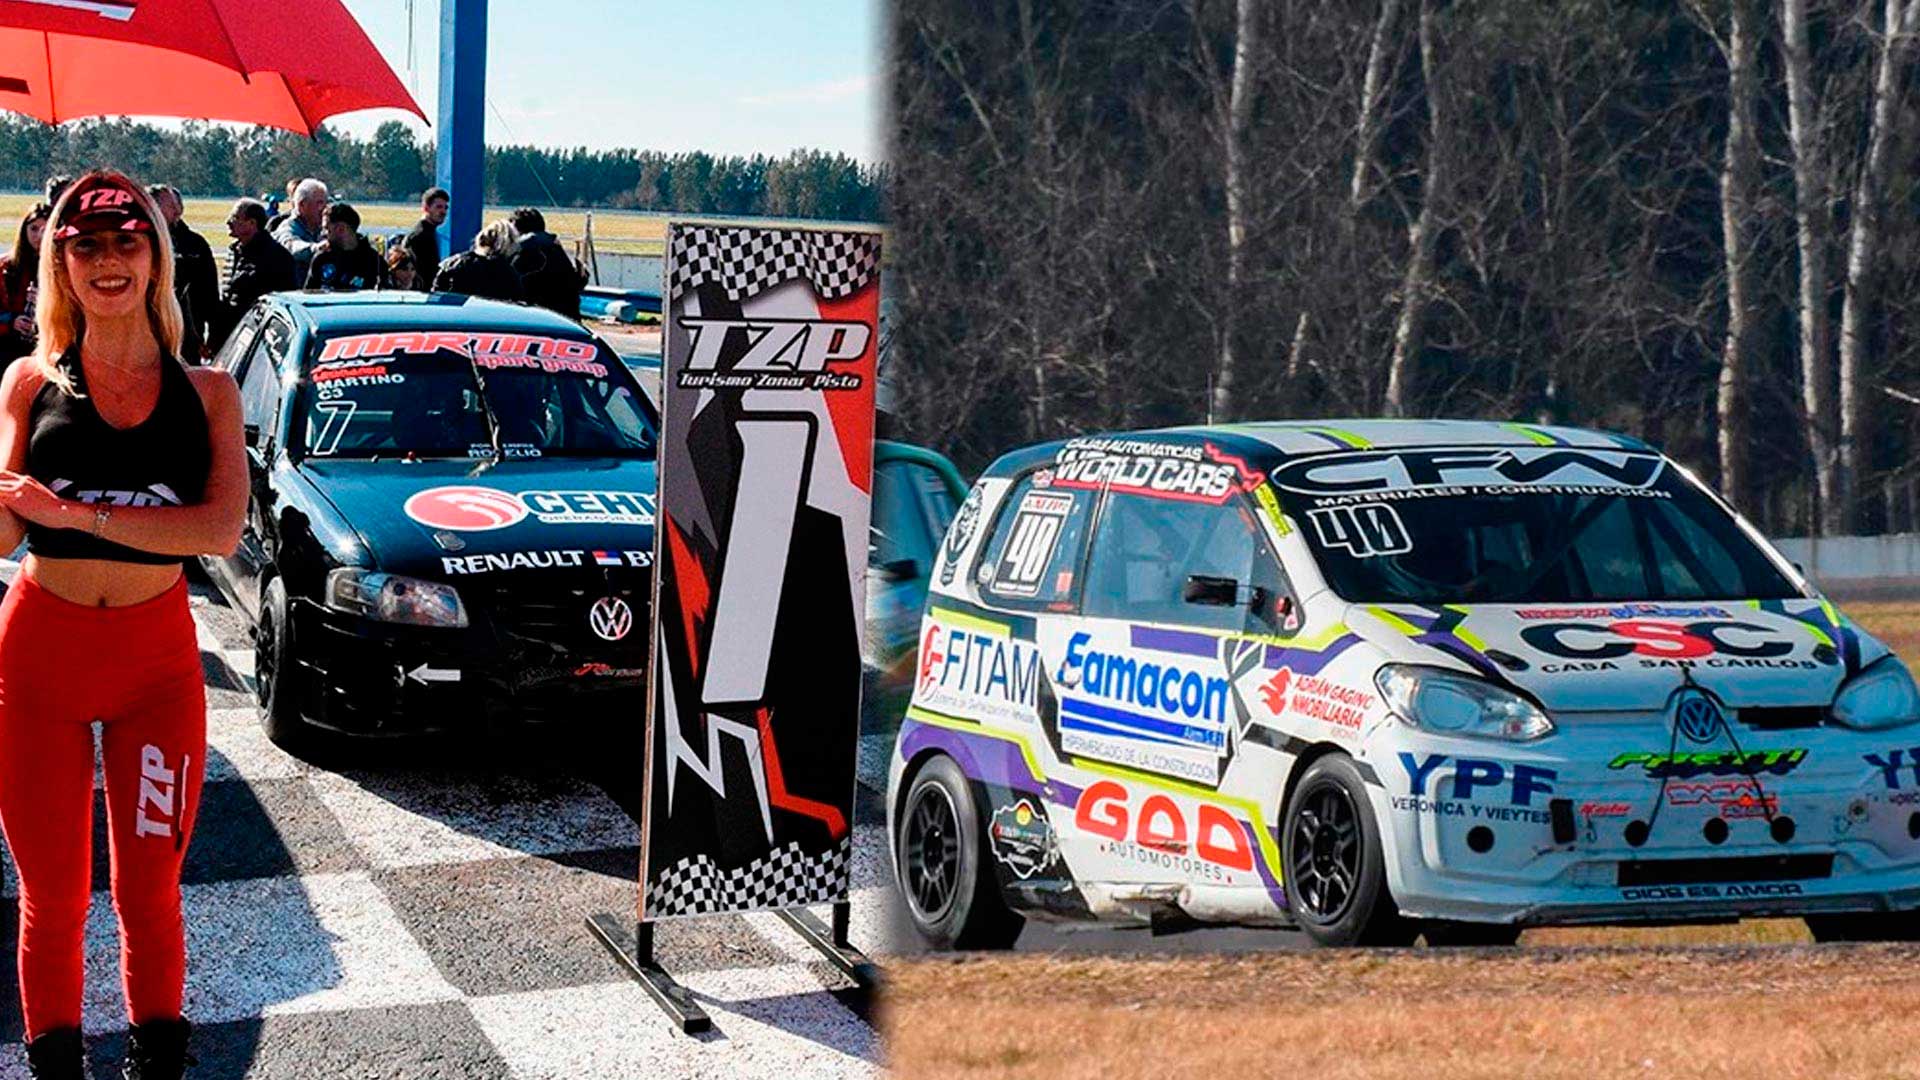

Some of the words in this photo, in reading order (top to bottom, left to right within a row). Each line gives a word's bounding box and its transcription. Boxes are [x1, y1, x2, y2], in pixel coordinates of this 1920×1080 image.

[79, 188, 134, 210] TZP
[318, 331, 598, 362] MARTINO
[679, 319, 871, 371] TZP
[316, 373, 405, 390] MARTINO
[317, 388, 344, 400] C3
[680, 372, 753, 386] Turismo
[812, 373, 860, 388] Pista
[311, 401, 357, 455] 7
[467, 448, 542, 457] ROELIO
[1151, 458, 1236, 497] CARS
[1270, 448, 1670, 496] CFW
[1314, 485, 1467, 507] MATERIALES
[1005, 513, 1061, 581] 40
[1306, 502, 1413, 558] 40
[441, 550, 584, 575] RENAULT
[623, 550, 656, 567] B
[1520, 620, 1794, 659] CSC
[1541, 660, 1619, 674] CASA
[1638, 659, 1697, 669] SAN
[1706, 658, 1819, 670] CARLOS
[1397, 752, 1559, 806] YPF
[1862, 747, 1920, 790] Y
[136, 744, 175, 838] TZP
[1392, 796, 1466, 817] VERONICA
[1471, 806, 1483, 817] Y
[1486, 807, 1552, 824] VIEYTES
[1108, 842, 1223, 881] AUTOMOTORES
[1623, 886, 1684, 900] DIOS
[1725, 883, 1804, 897] AMOR
